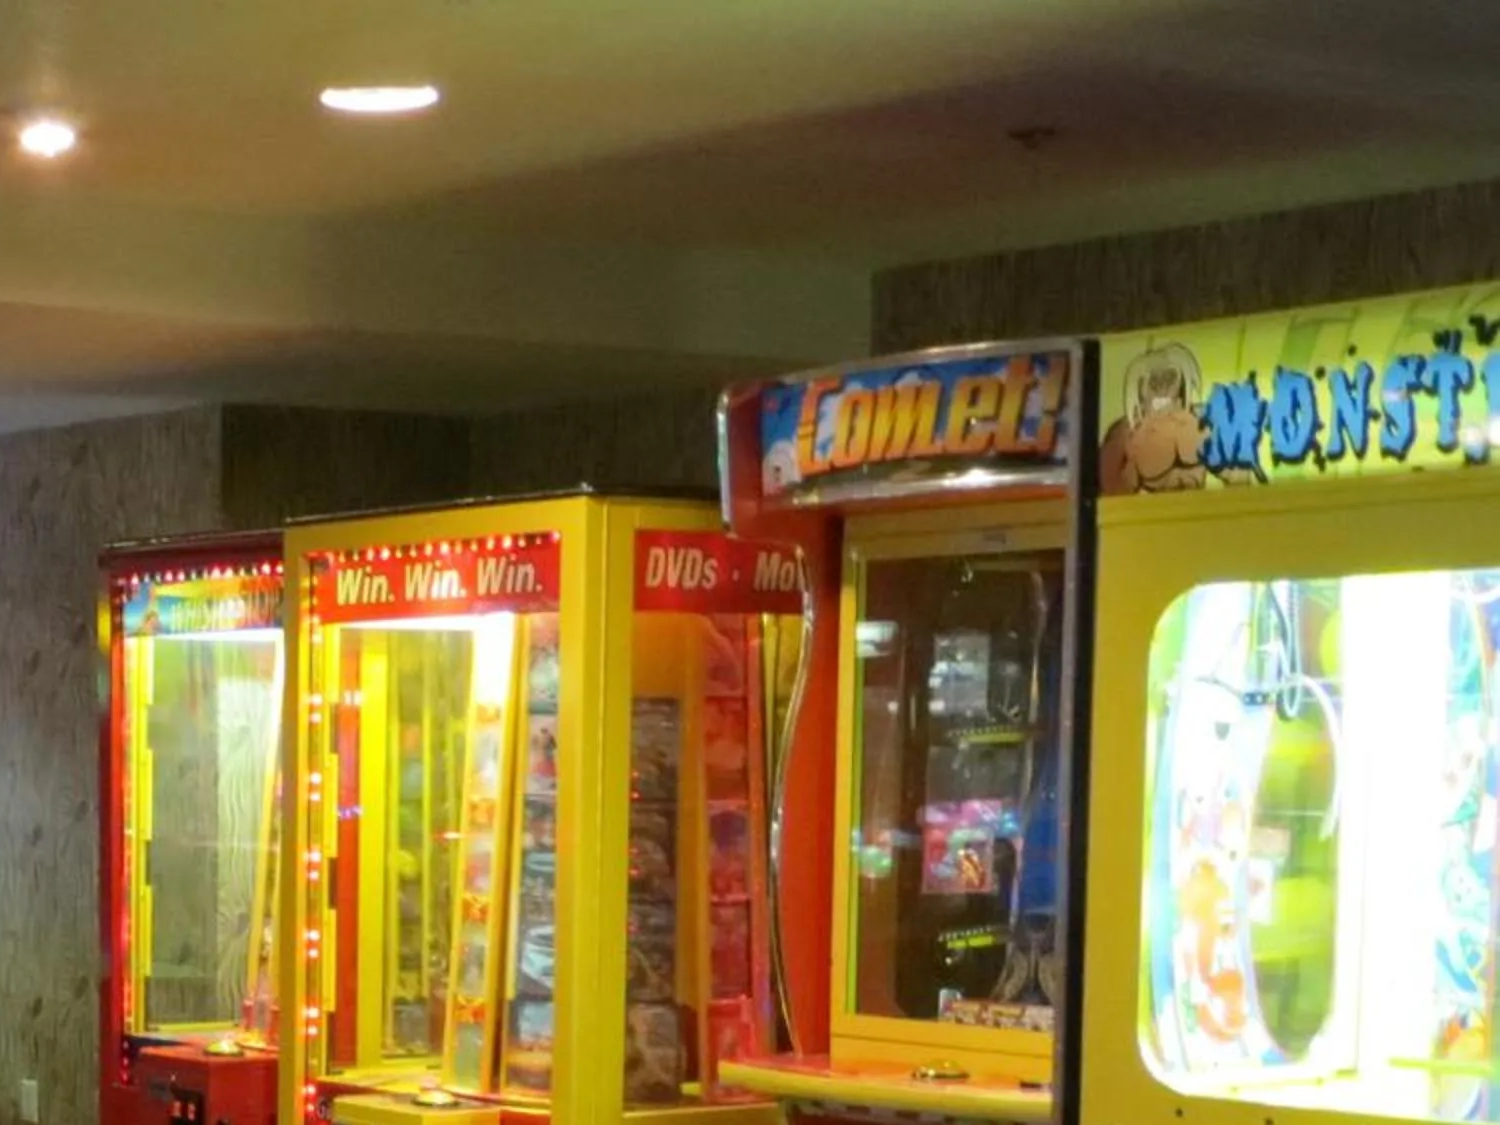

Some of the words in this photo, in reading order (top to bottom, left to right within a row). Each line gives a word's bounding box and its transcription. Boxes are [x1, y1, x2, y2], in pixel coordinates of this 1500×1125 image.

[794, 352, 1069, 478] Comet!
[336, 564, 395, 606] Win.
[404, 559, 467, 601] Win.
[476, 553, 543, 596] Win.
[645, 546, 719, 590] DVDs
